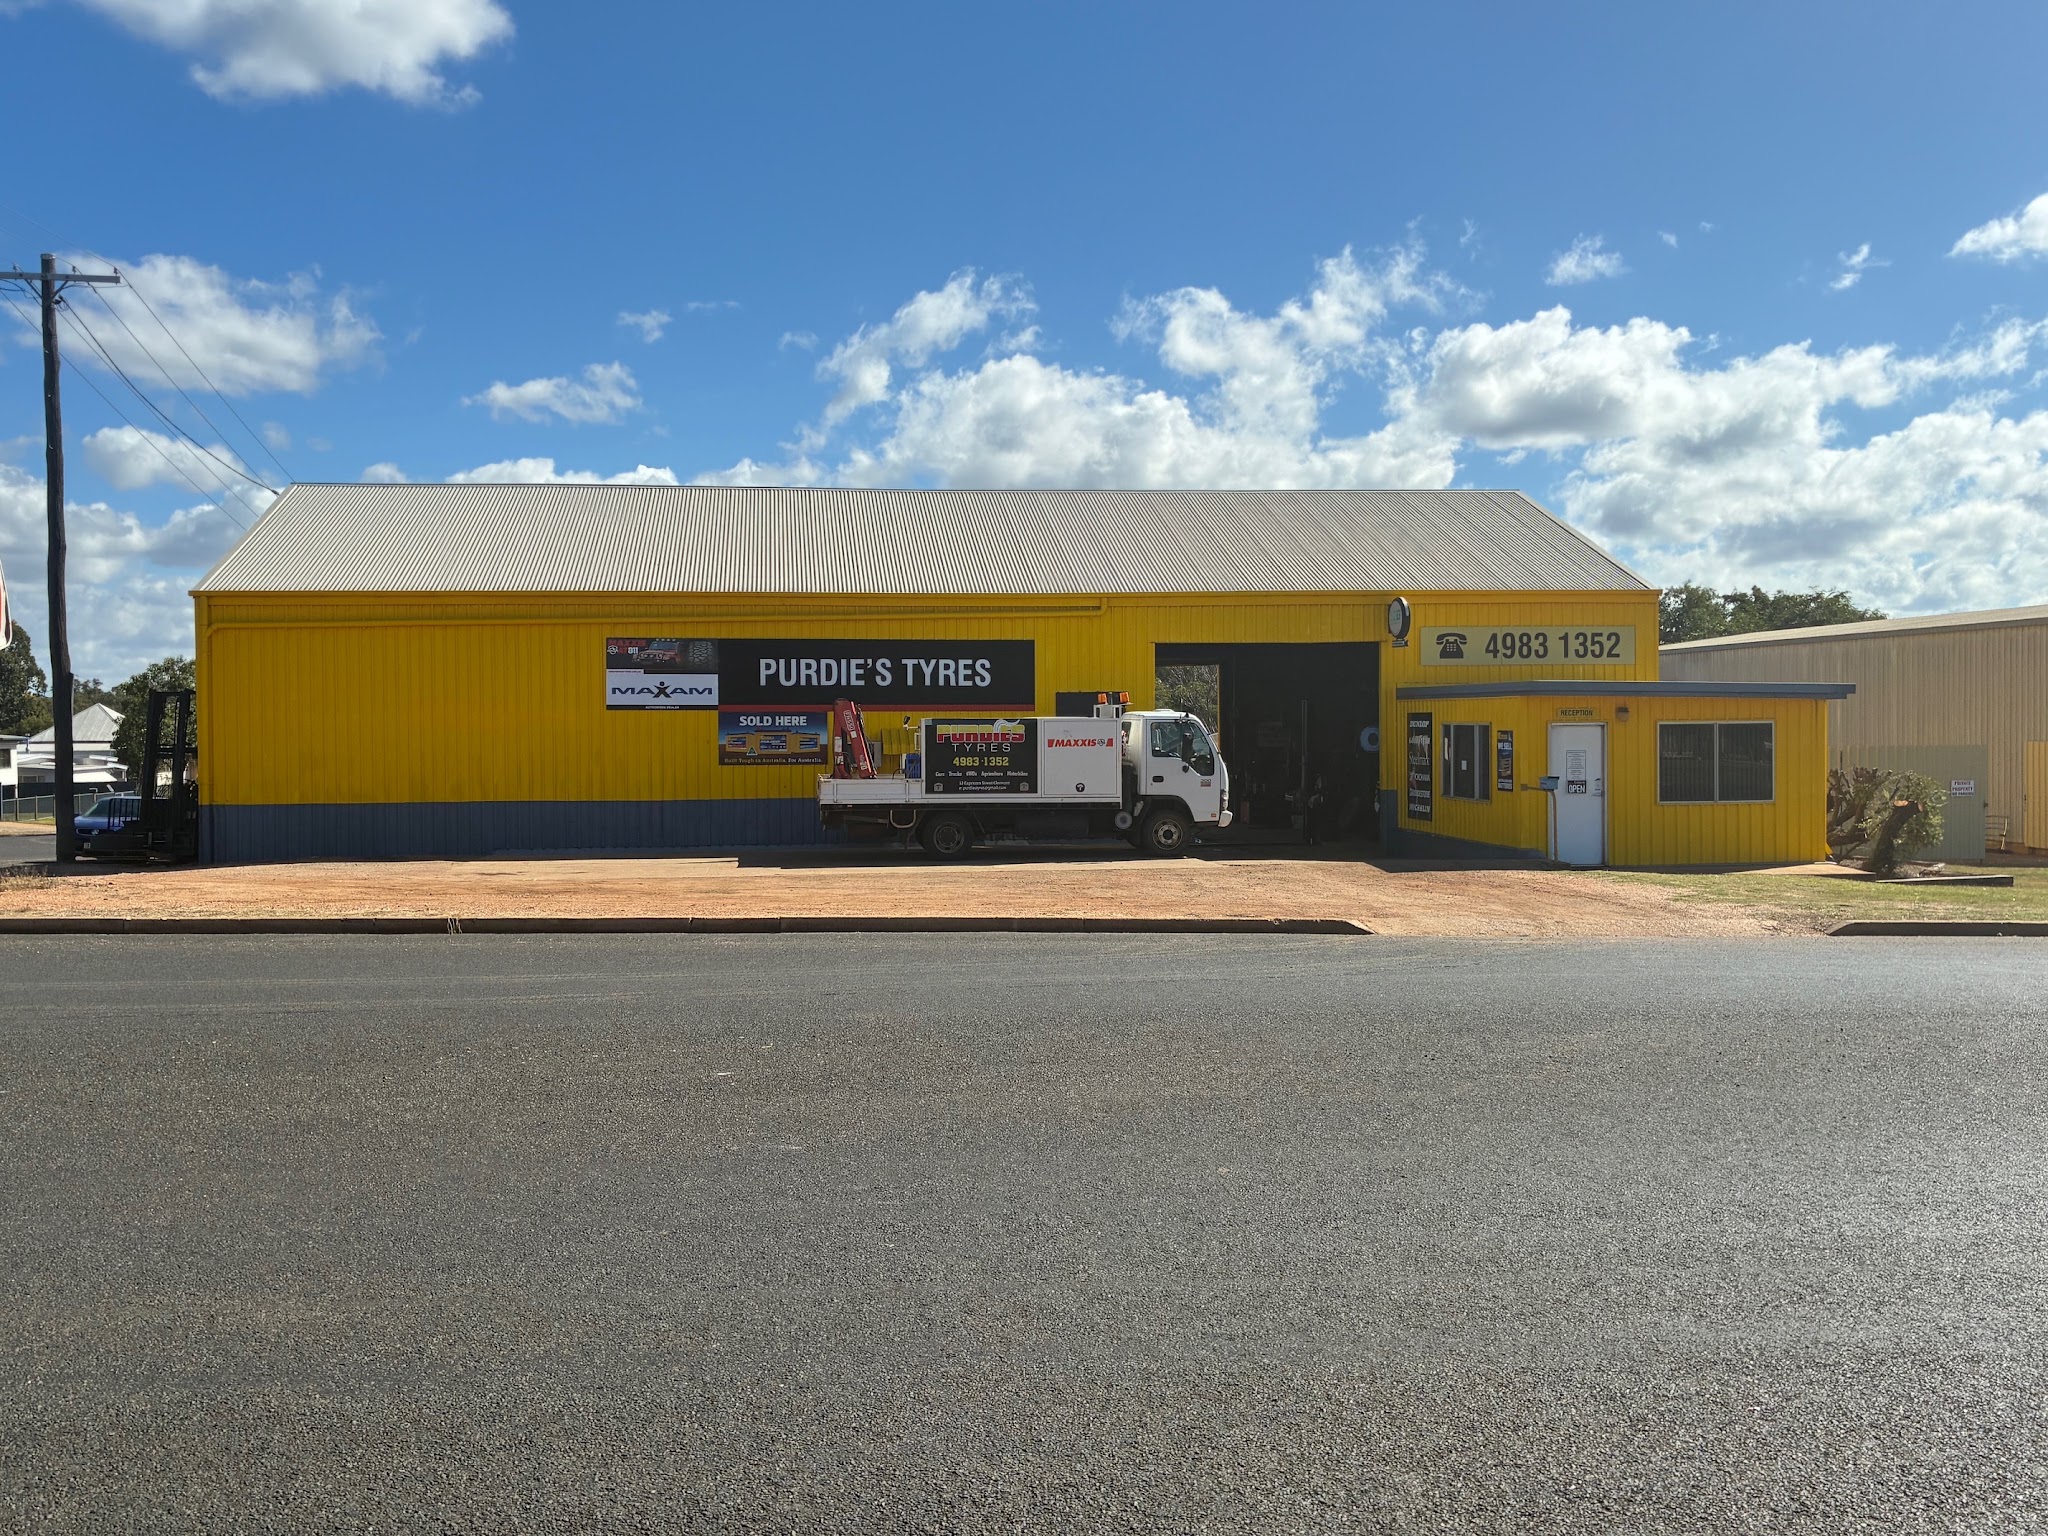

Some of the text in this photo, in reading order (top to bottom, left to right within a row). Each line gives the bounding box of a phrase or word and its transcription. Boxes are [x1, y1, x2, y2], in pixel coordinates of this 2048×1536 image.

[1485, 632, 1620, 659] 4983 1352
[759, 658, 992, 687] PURDIE'S TYRES
[611, 682, 713, 698] MAXAM
[739, 716, 807, 726] SOLD HERE
[951, 743, 1011, 752] TYRES
[1054, 738, 1097, 748] MAXXIS
[1569, 784, 1586, 793] OPEN
